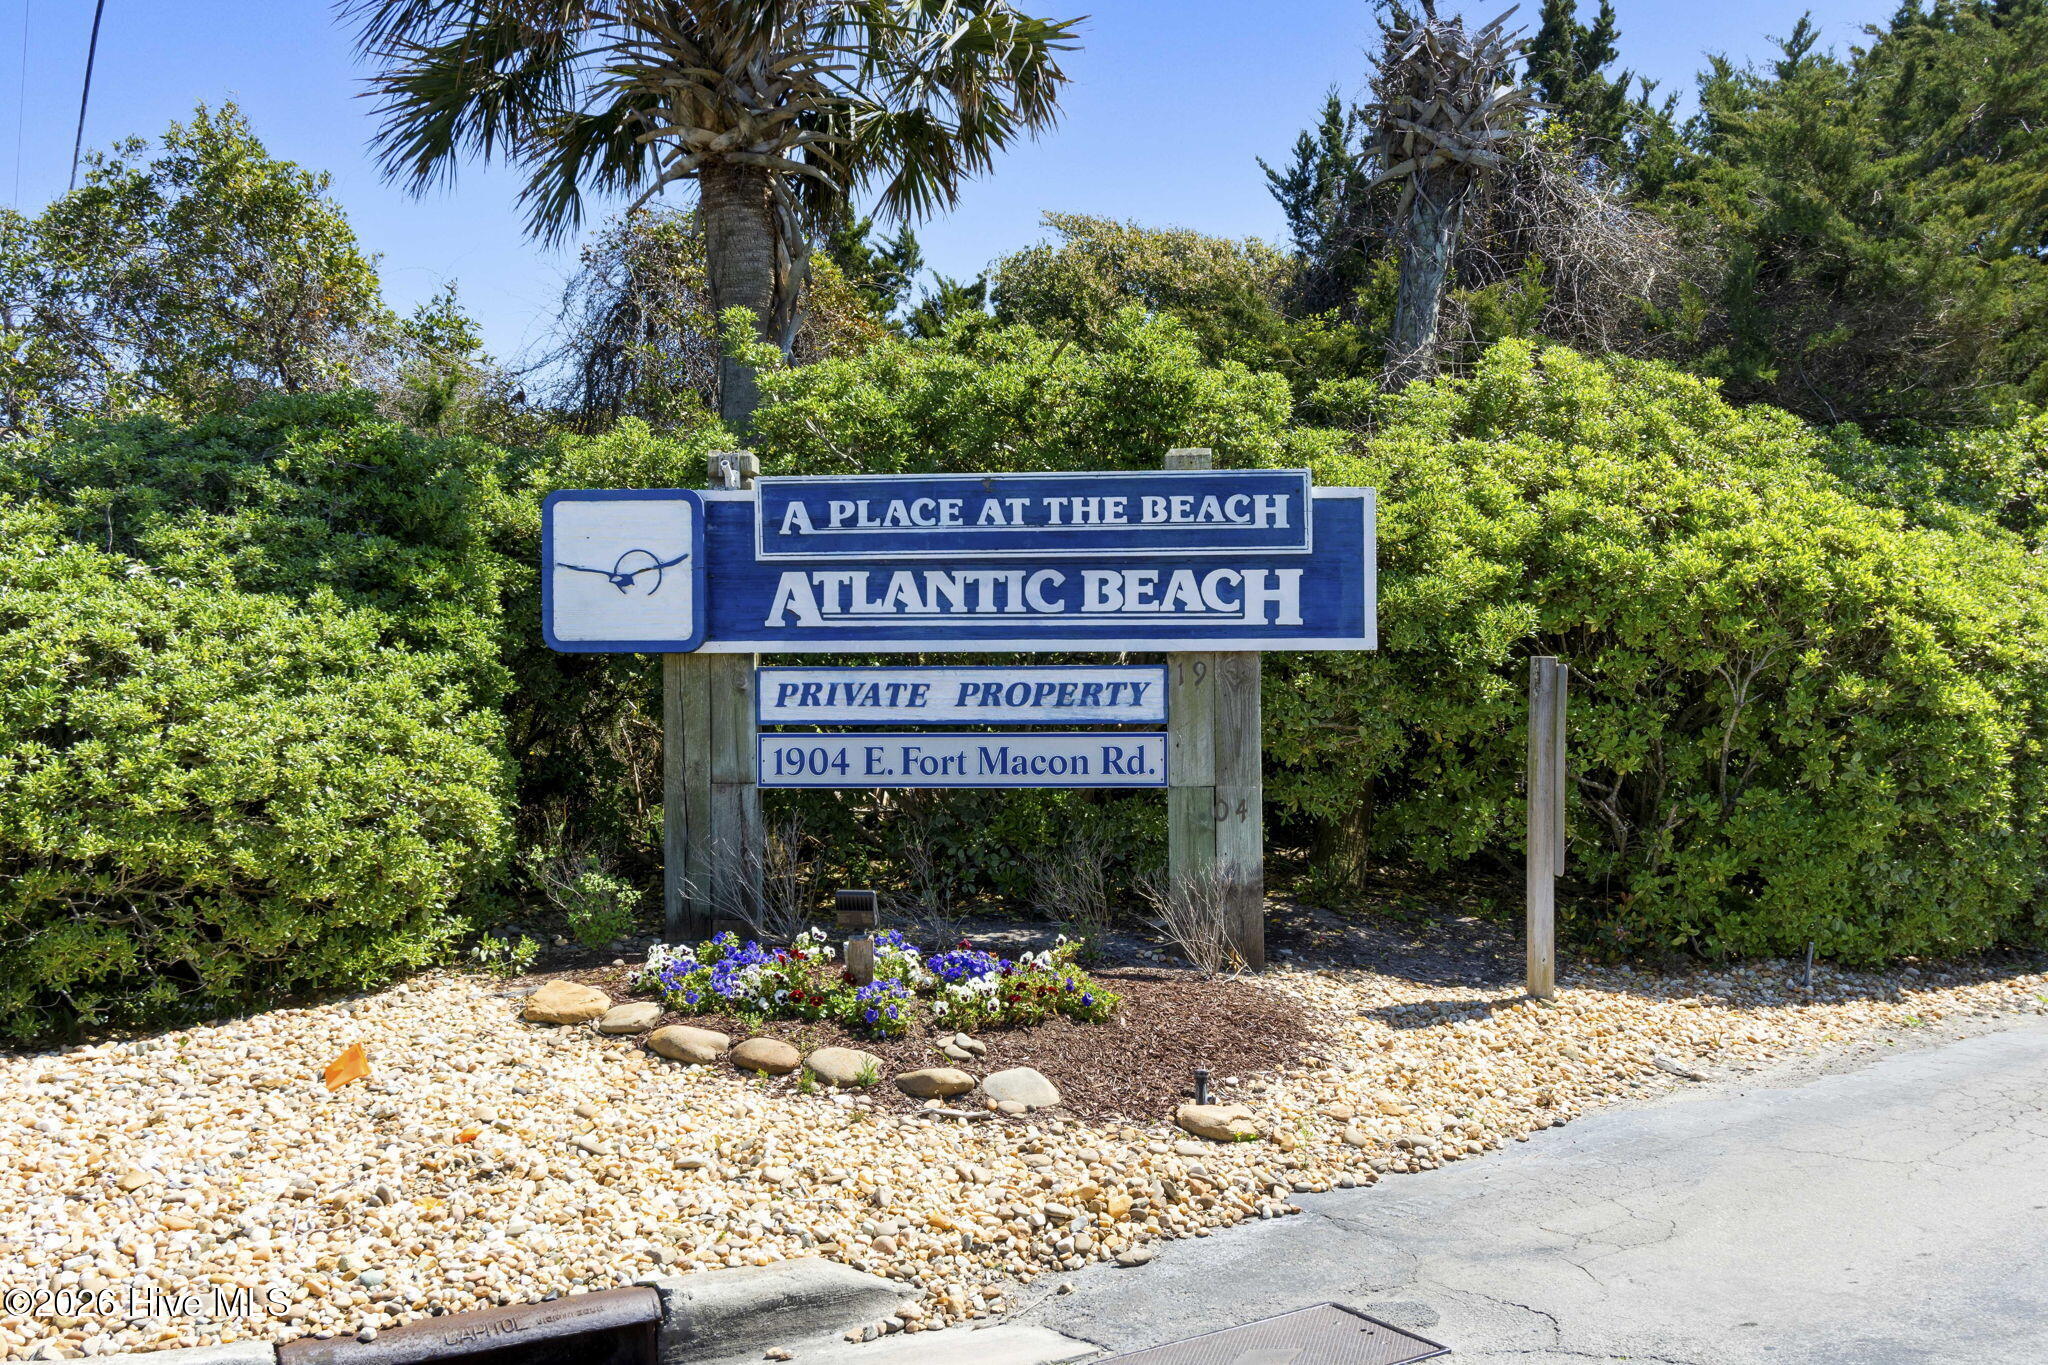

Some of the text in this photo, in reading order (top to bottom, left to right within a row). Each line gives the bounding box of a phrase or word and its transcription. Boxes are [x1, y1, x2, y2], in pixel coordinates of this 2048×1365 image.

[779, 493, 1291, 535] A PLACE AT THE BEACH
[764, 567, 1304, 628] ATLANTIC BEACH
[774, 681, 1152, 708] PRIVATE PROPERTY
[773, 743, 1156, 777] 1904 E. Fort Macon Rd.
[1213, 798, 1249, 824] 04
[443, 1315, 529, 1347] CAPITOL
